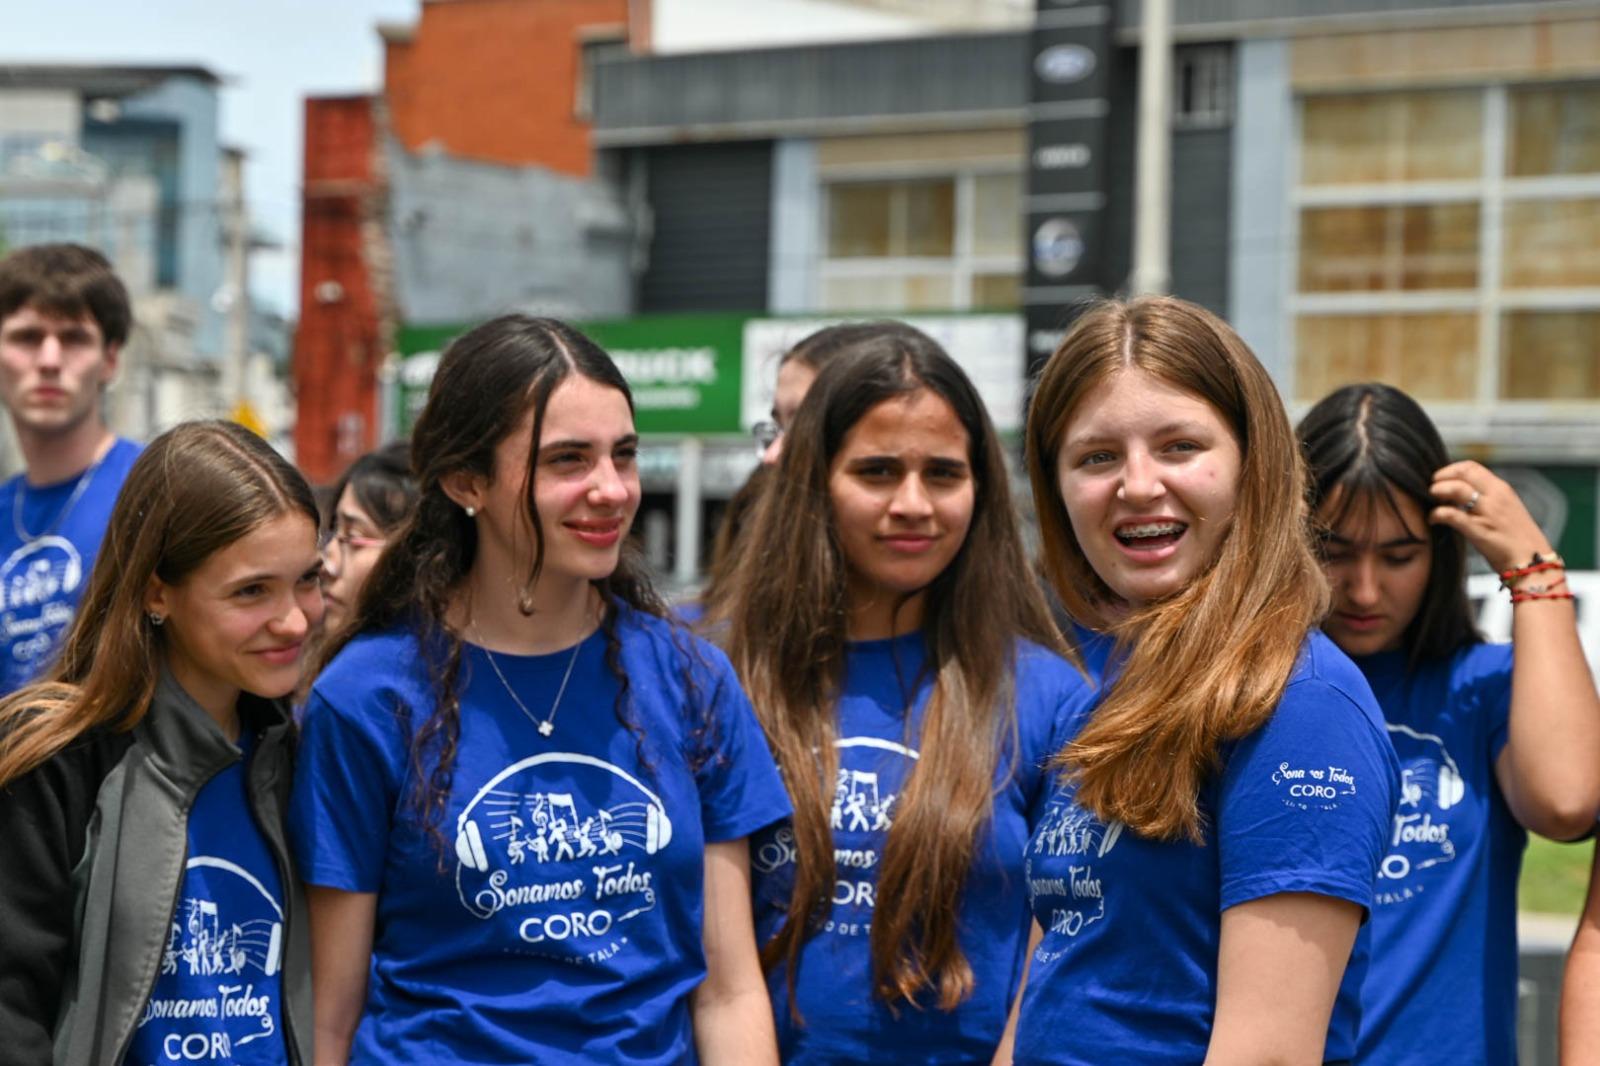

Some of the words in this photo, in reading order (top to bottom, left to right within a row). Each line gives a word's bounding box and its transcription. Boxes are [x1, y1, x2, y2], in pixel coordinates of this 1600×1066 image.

[1289, 784, 1336, 799] CORO
[1328, 766, 1355, 785] Todos
[1392, 813, 1450, 847] Todos
[475, 869, 586, 911] Sonamos
[592, 862, 653, 900] Todos
[831, 880, 875, 907] OR
[1068, 865, 1102, 899] Todos
[519, 909, 612, 943] CORO
[588, 942, 620, 963] TALA
[218, 984, 270, 1021] Todos
